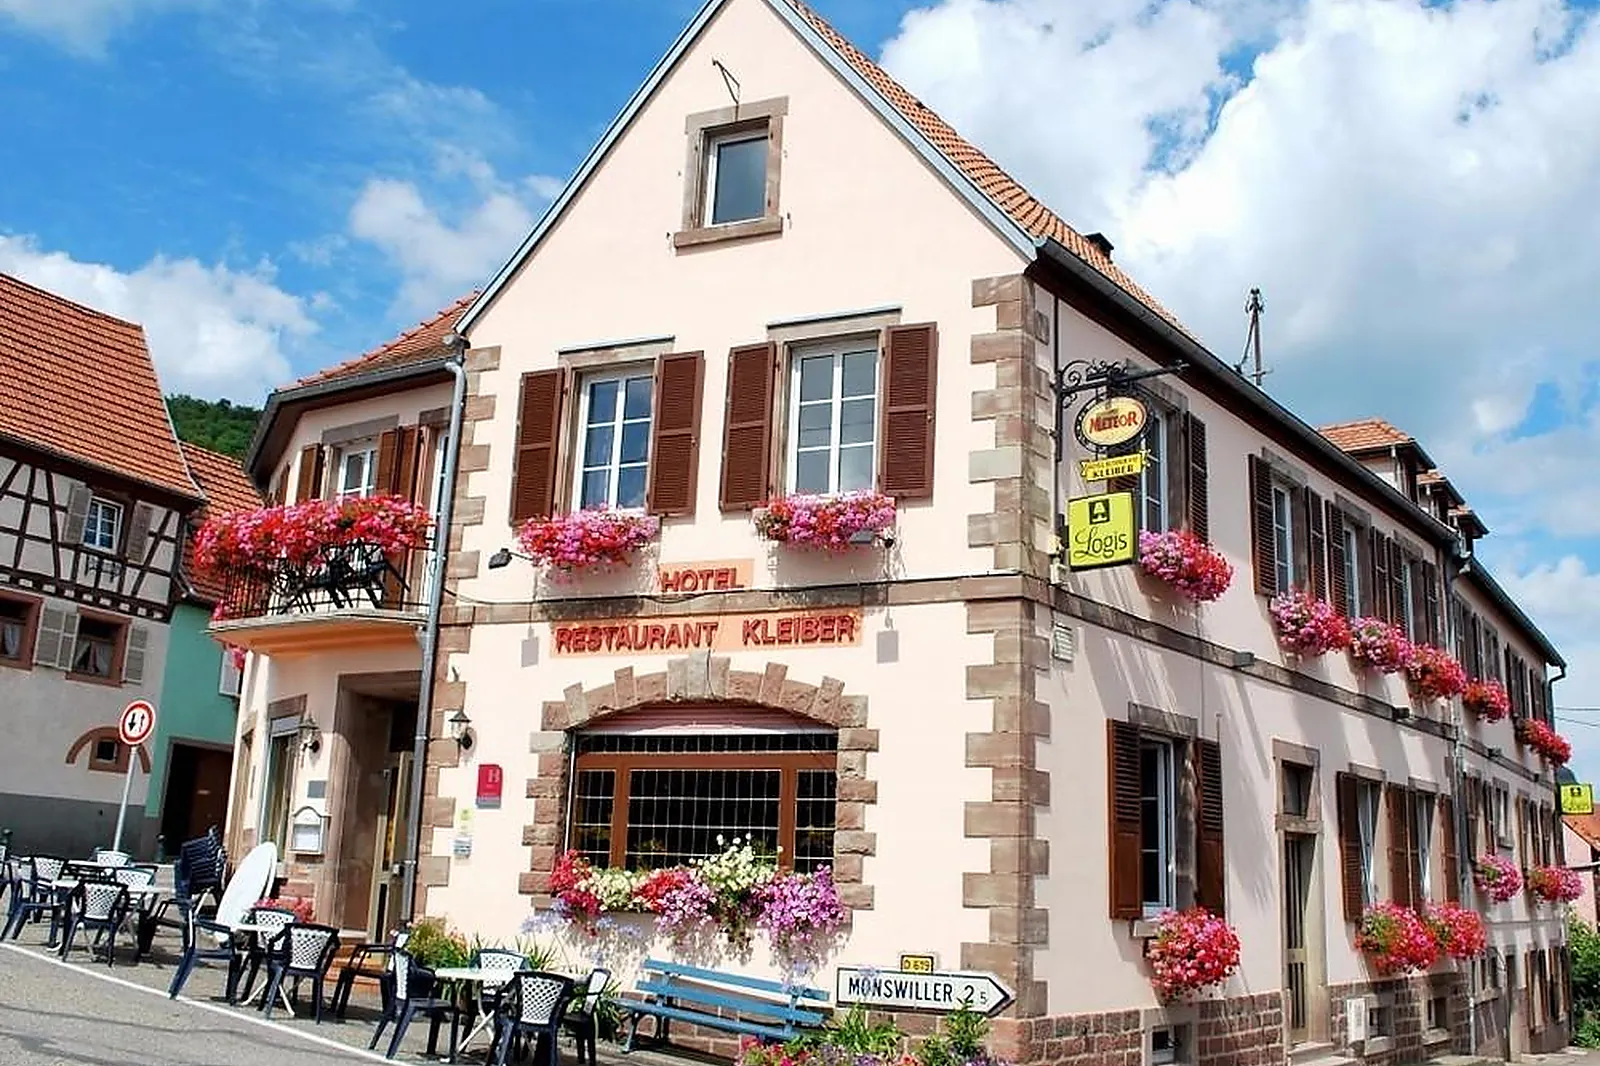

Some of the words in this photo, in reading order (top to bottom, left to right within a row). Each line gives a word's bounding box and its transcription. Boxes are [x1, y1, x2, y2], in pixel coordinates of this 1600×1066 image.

[1073, 526, 1127, 559] Logis
[661, 568, 744, 592] HOTEL
[556, 621, 718, 653] RESTAURANT
[742, 615, 855, 645] KLEIBER
[848, 977, 953, 1003] MONSWILLER
